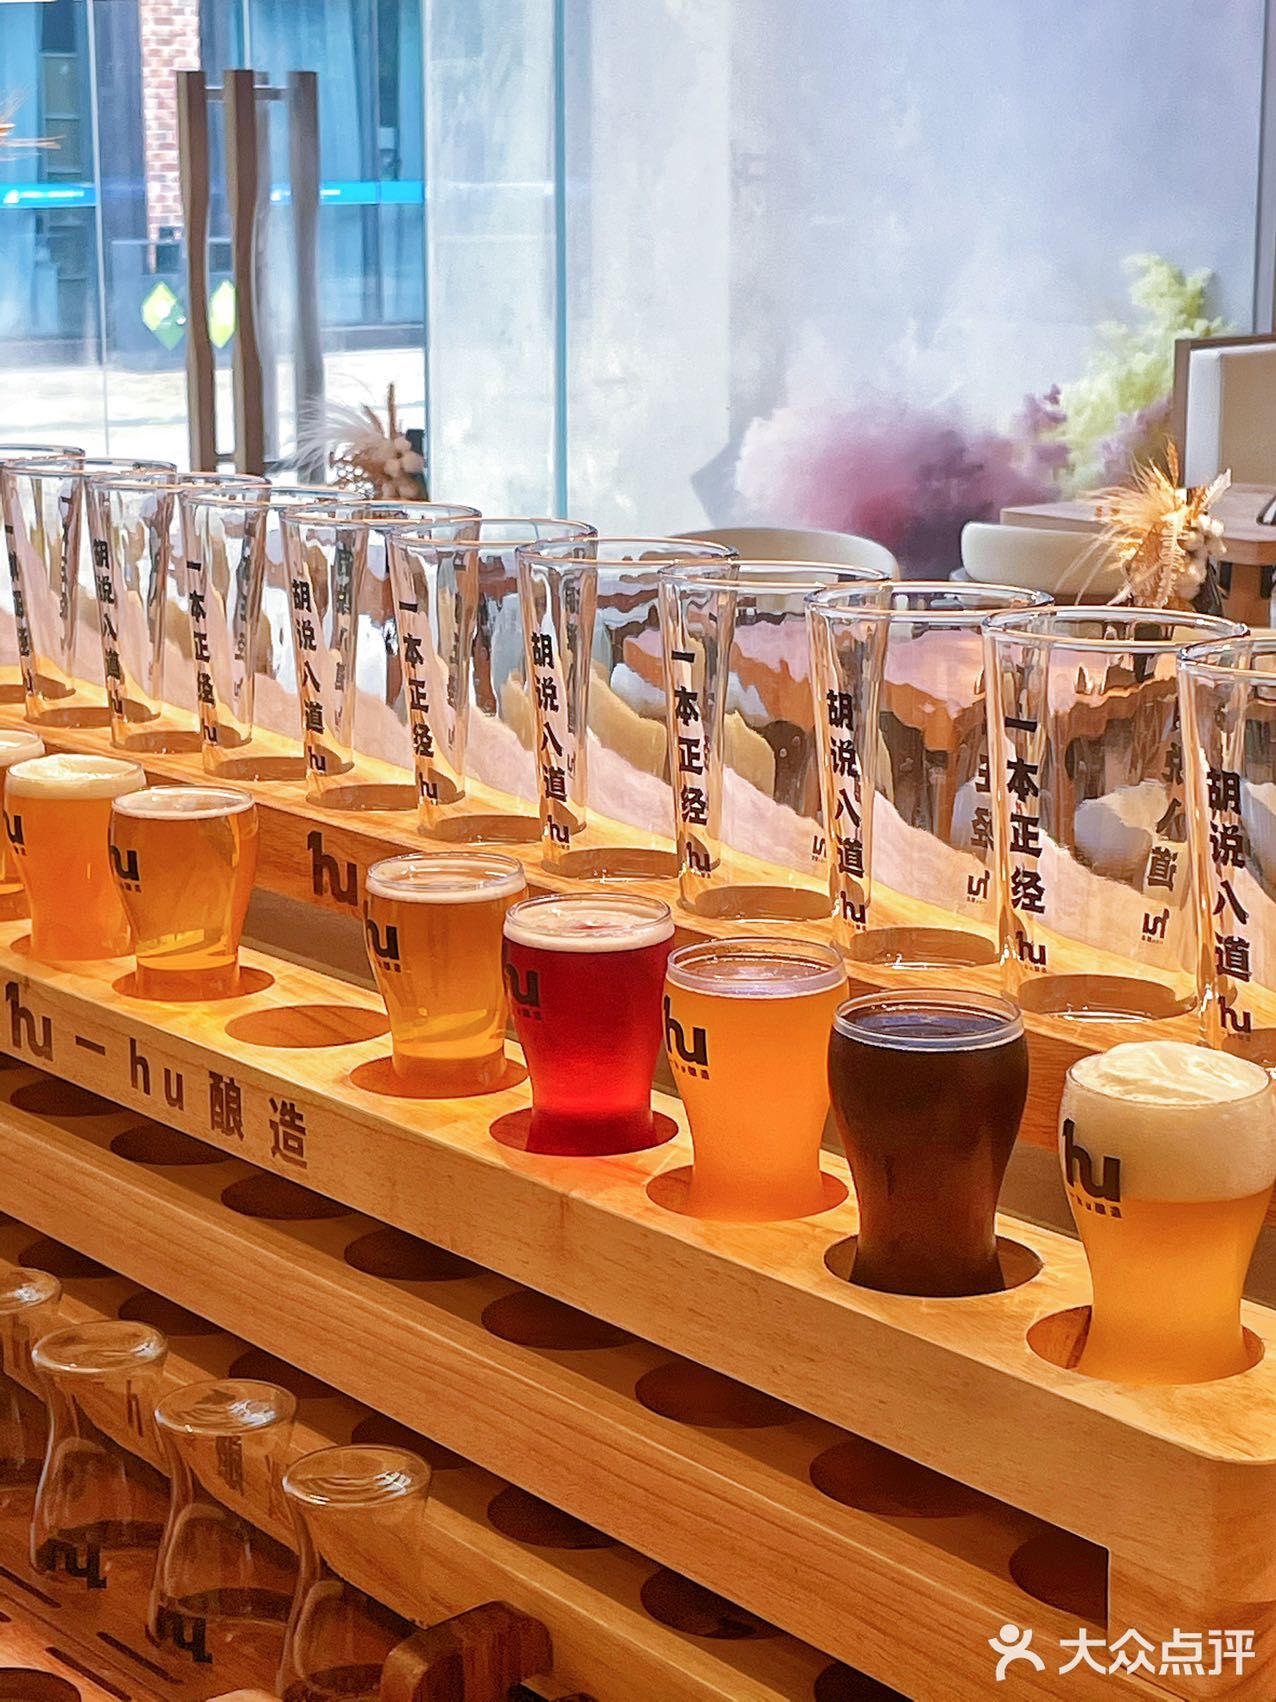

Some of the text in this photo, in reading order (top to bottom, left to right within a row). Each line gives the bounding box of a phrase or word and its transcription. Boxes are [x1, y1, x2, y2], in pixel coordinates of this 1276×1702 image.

[292, 578, 324, 735] 胡说八道
[398, 600, 435, 758] 一本正经
[530, 631, 569, 803] 胡说八道
[670, 650, 708, 825] 一本正经
[418, 772, 438, 804] hu
[825, 688, 866, 879] 胡说八道
[1004, 716, 1047, 914] 一本正经
[307, 831, 358, 906] hu
[546, 814, 570, 844] hu
[685, 840, 712, 872] hu
[840, 890, 867, 925] hu
[1206, 768, 1252, 983] 胡说八道
[1015, 930, 1047, 966] hu
[5, 981, 54, 1062] hu
[664, 995, 709, 1066] hu
[1217, 996, 1252, 1034] hu
[1062, 1118, 1121, 1203] hu
